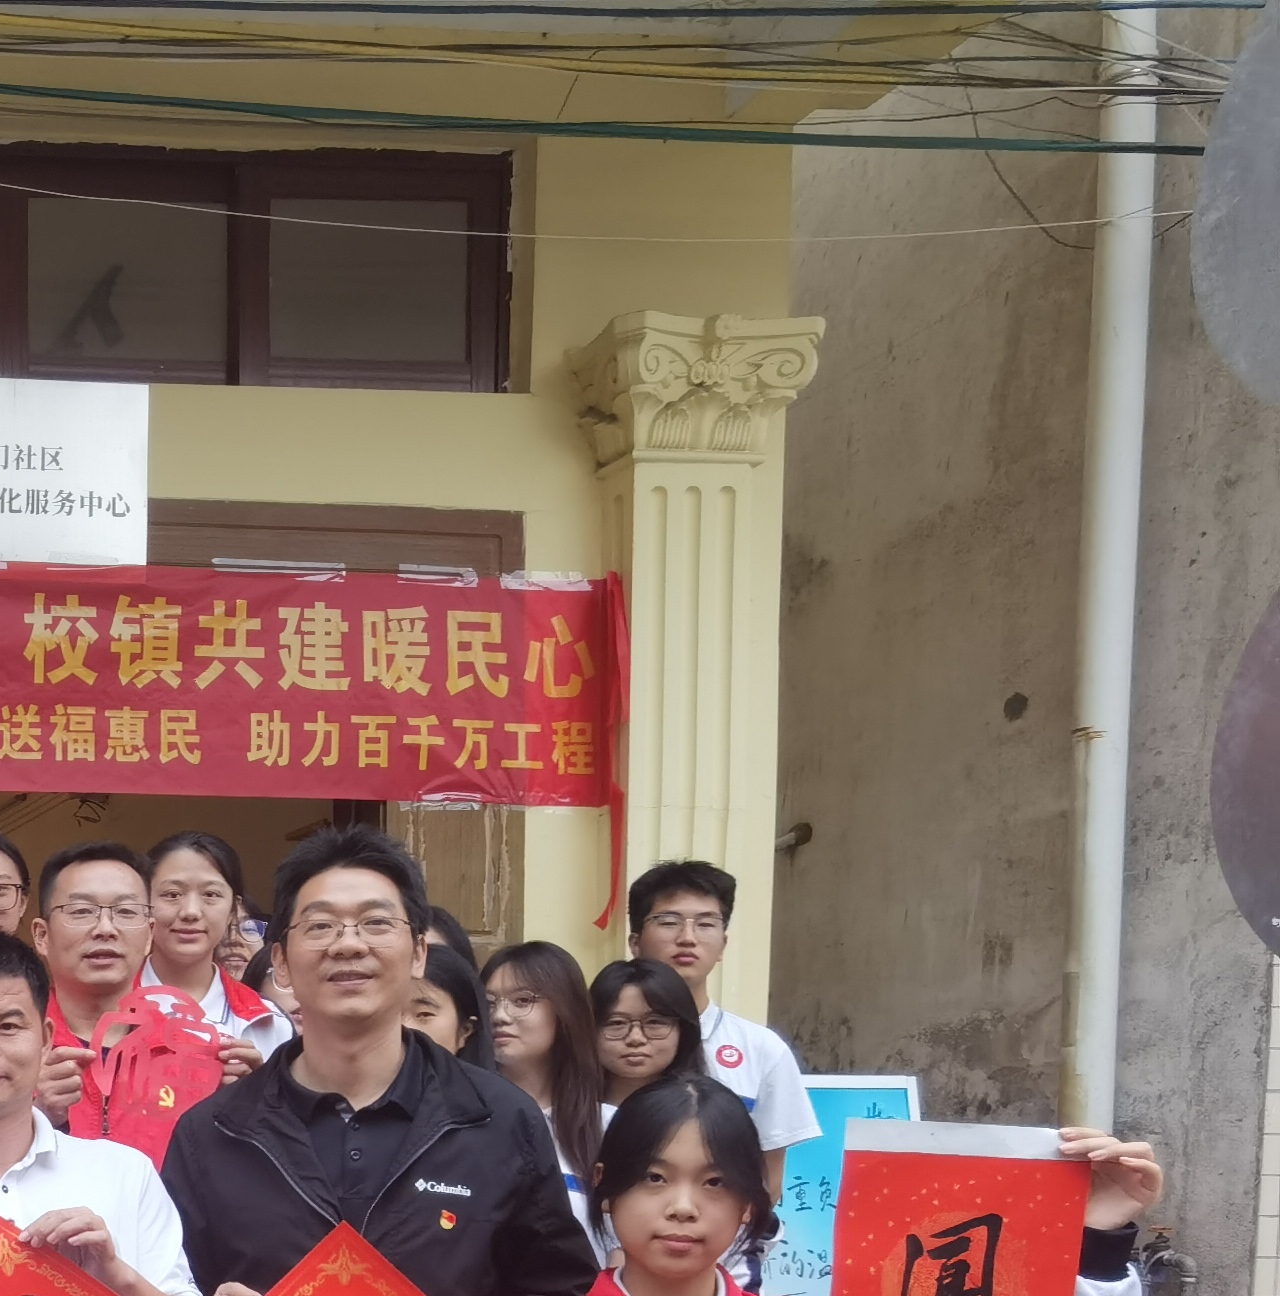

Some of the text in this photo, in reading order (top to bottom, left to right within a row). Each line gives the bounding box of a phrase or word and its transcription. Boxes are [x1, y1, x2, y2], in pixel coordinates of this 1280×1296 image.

[23, 592, 596, 699] 校镇共建暖民心
[247, 708, 596, 776] 助力百千万工程
[427, 1181, 471, 1197] Columbia
